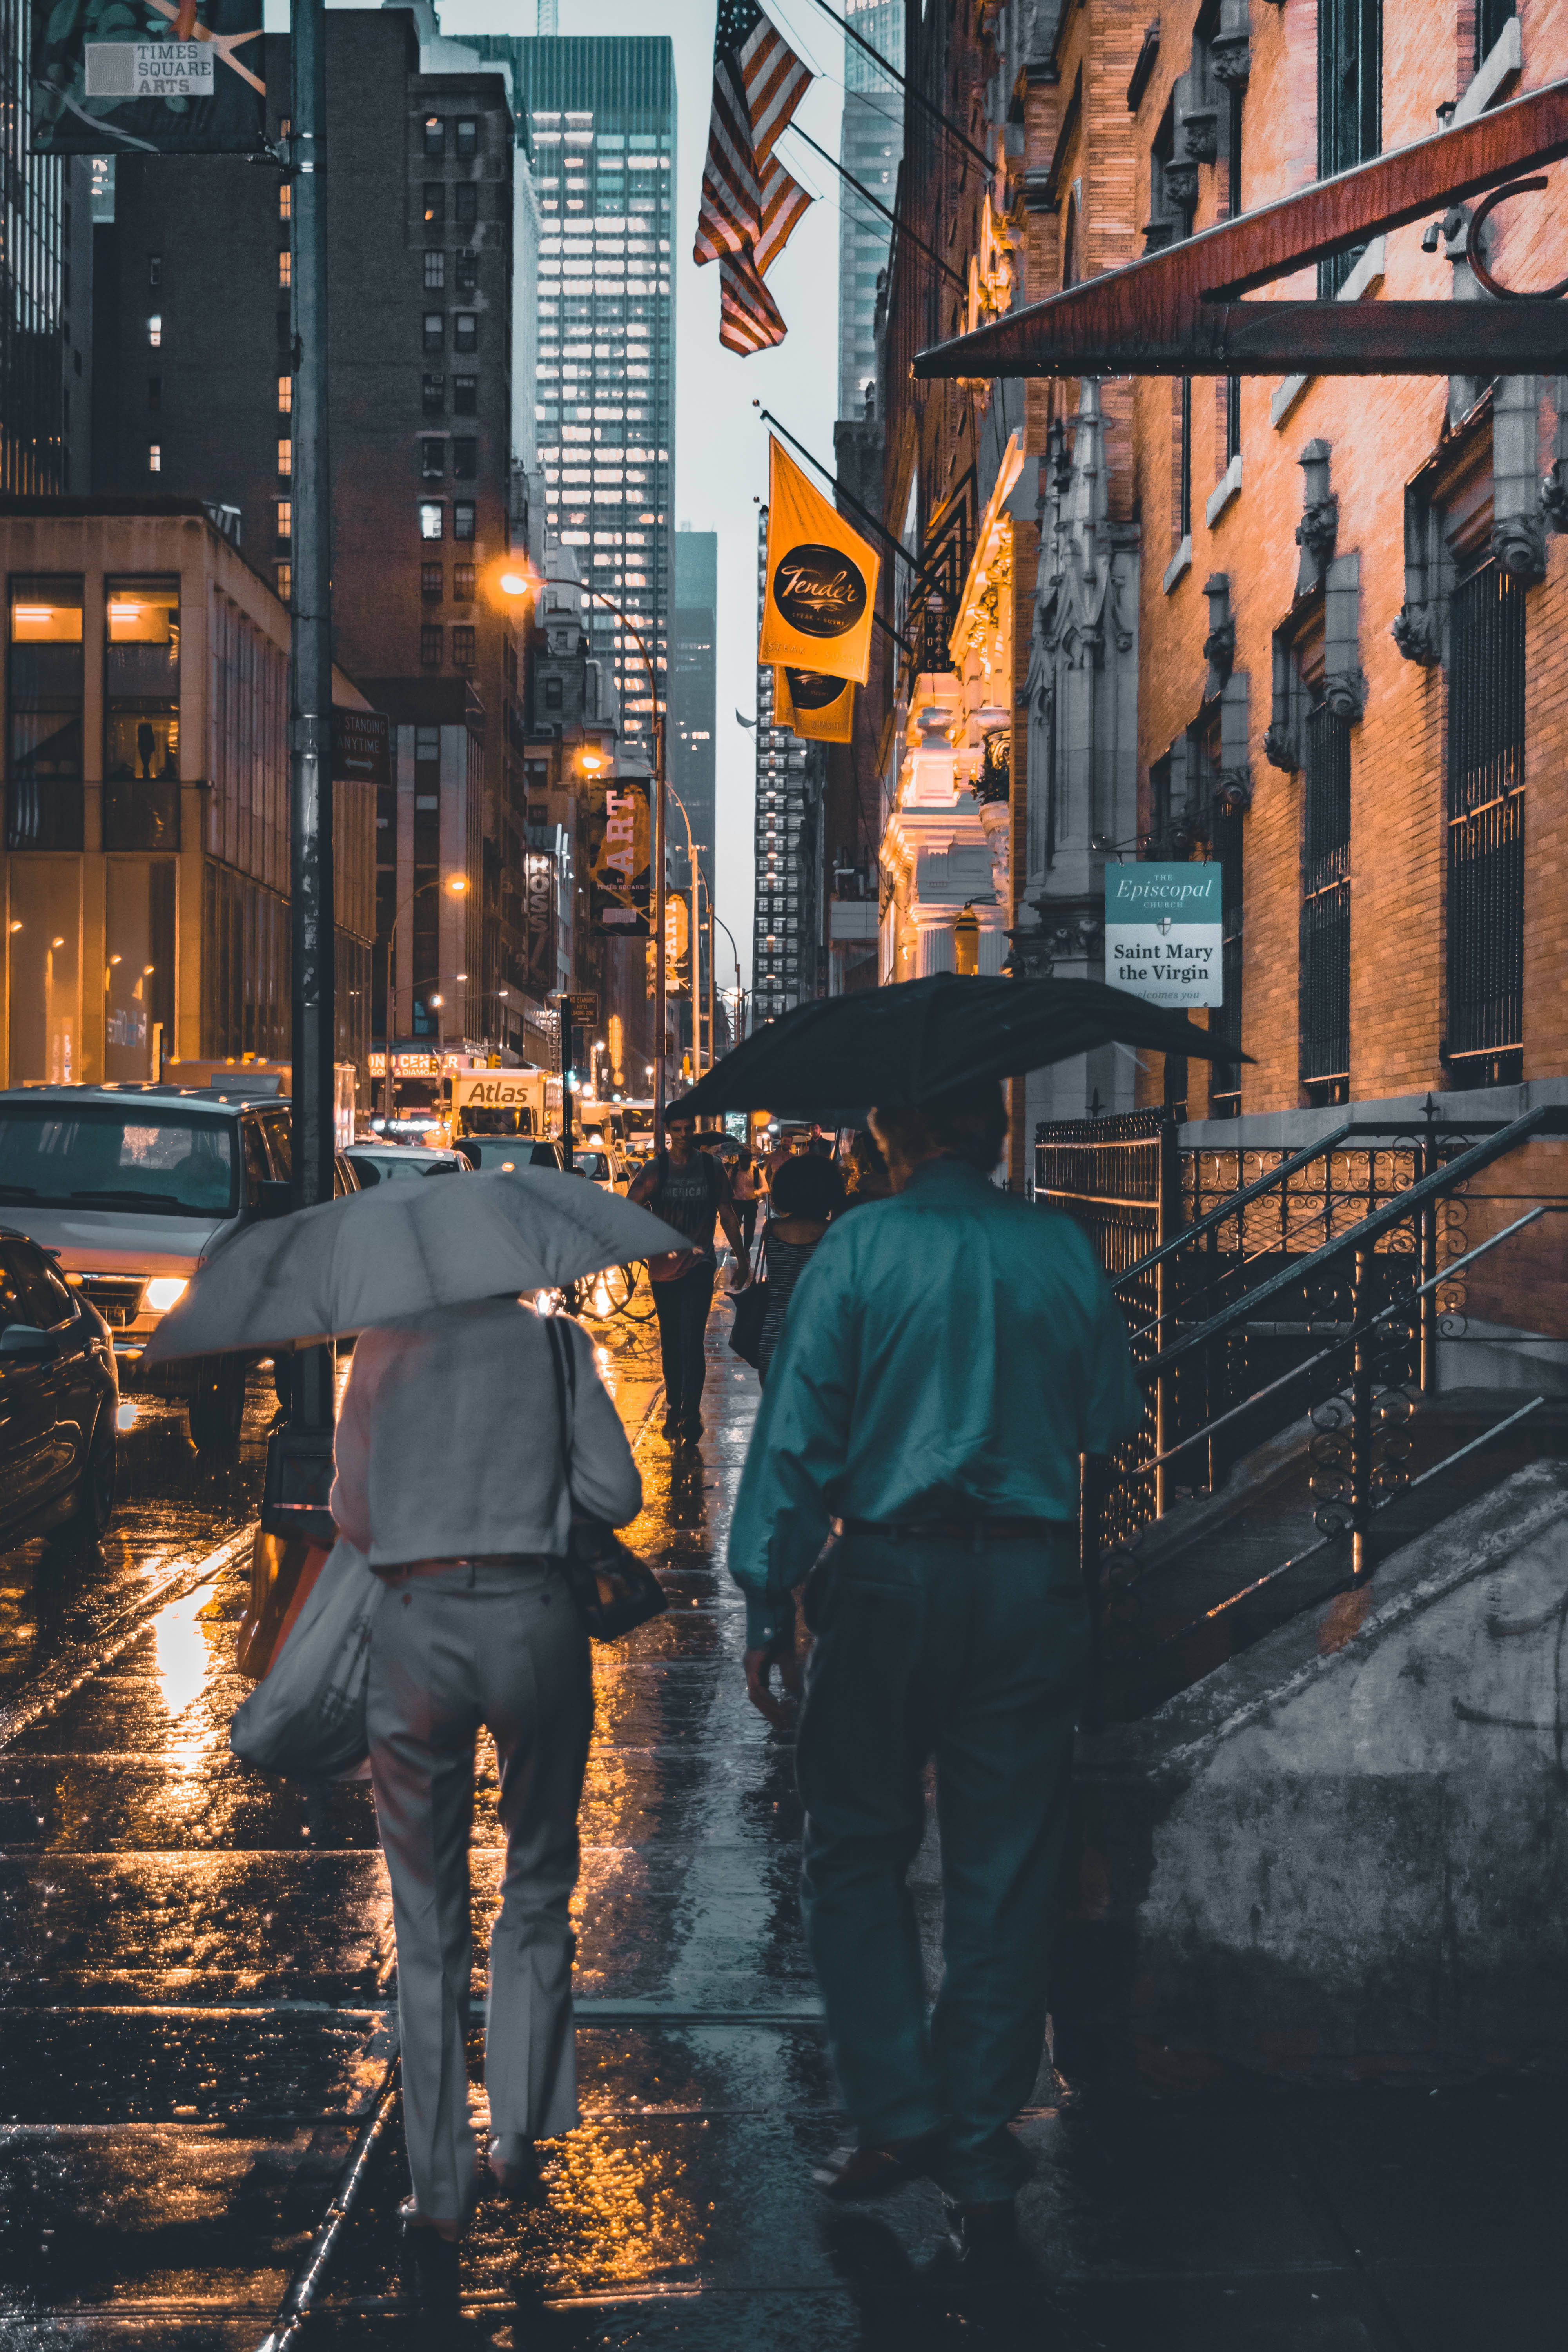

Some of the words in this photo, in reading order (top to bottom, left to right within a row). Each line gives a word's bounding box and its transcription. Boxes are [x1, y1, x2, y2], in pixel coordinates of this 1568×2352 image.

[138, 45, 198, 59] TIMES
[138, 62, 211, 77] SQUARE
[139, 79, 189, 93] ARTS
[780, 564, 860, 603] Tender
[768, 643, 805, 655] STEAK
[824, 651, 860, 666] SUSHI
[345, 715, 385, 735] STANDING
[338, 735, 379, 753] ANYTIME
[606, 790, 634, 875] ART
[529, 855, 550, 933] ROSS
[1116, 879, 1212, 901] Episcopal
[1114, 944, 1160, 959] Saint
[1166, 944, 1213, 962] Mary
[1119, 966, 1147, 980] the
[1152, 965, 1209, 983] Virgin
[1181, 992, 1200, 1000] you
[400, 1055, 458, 1068] CENR
[468, 1082, 528, 1102] Atlas
